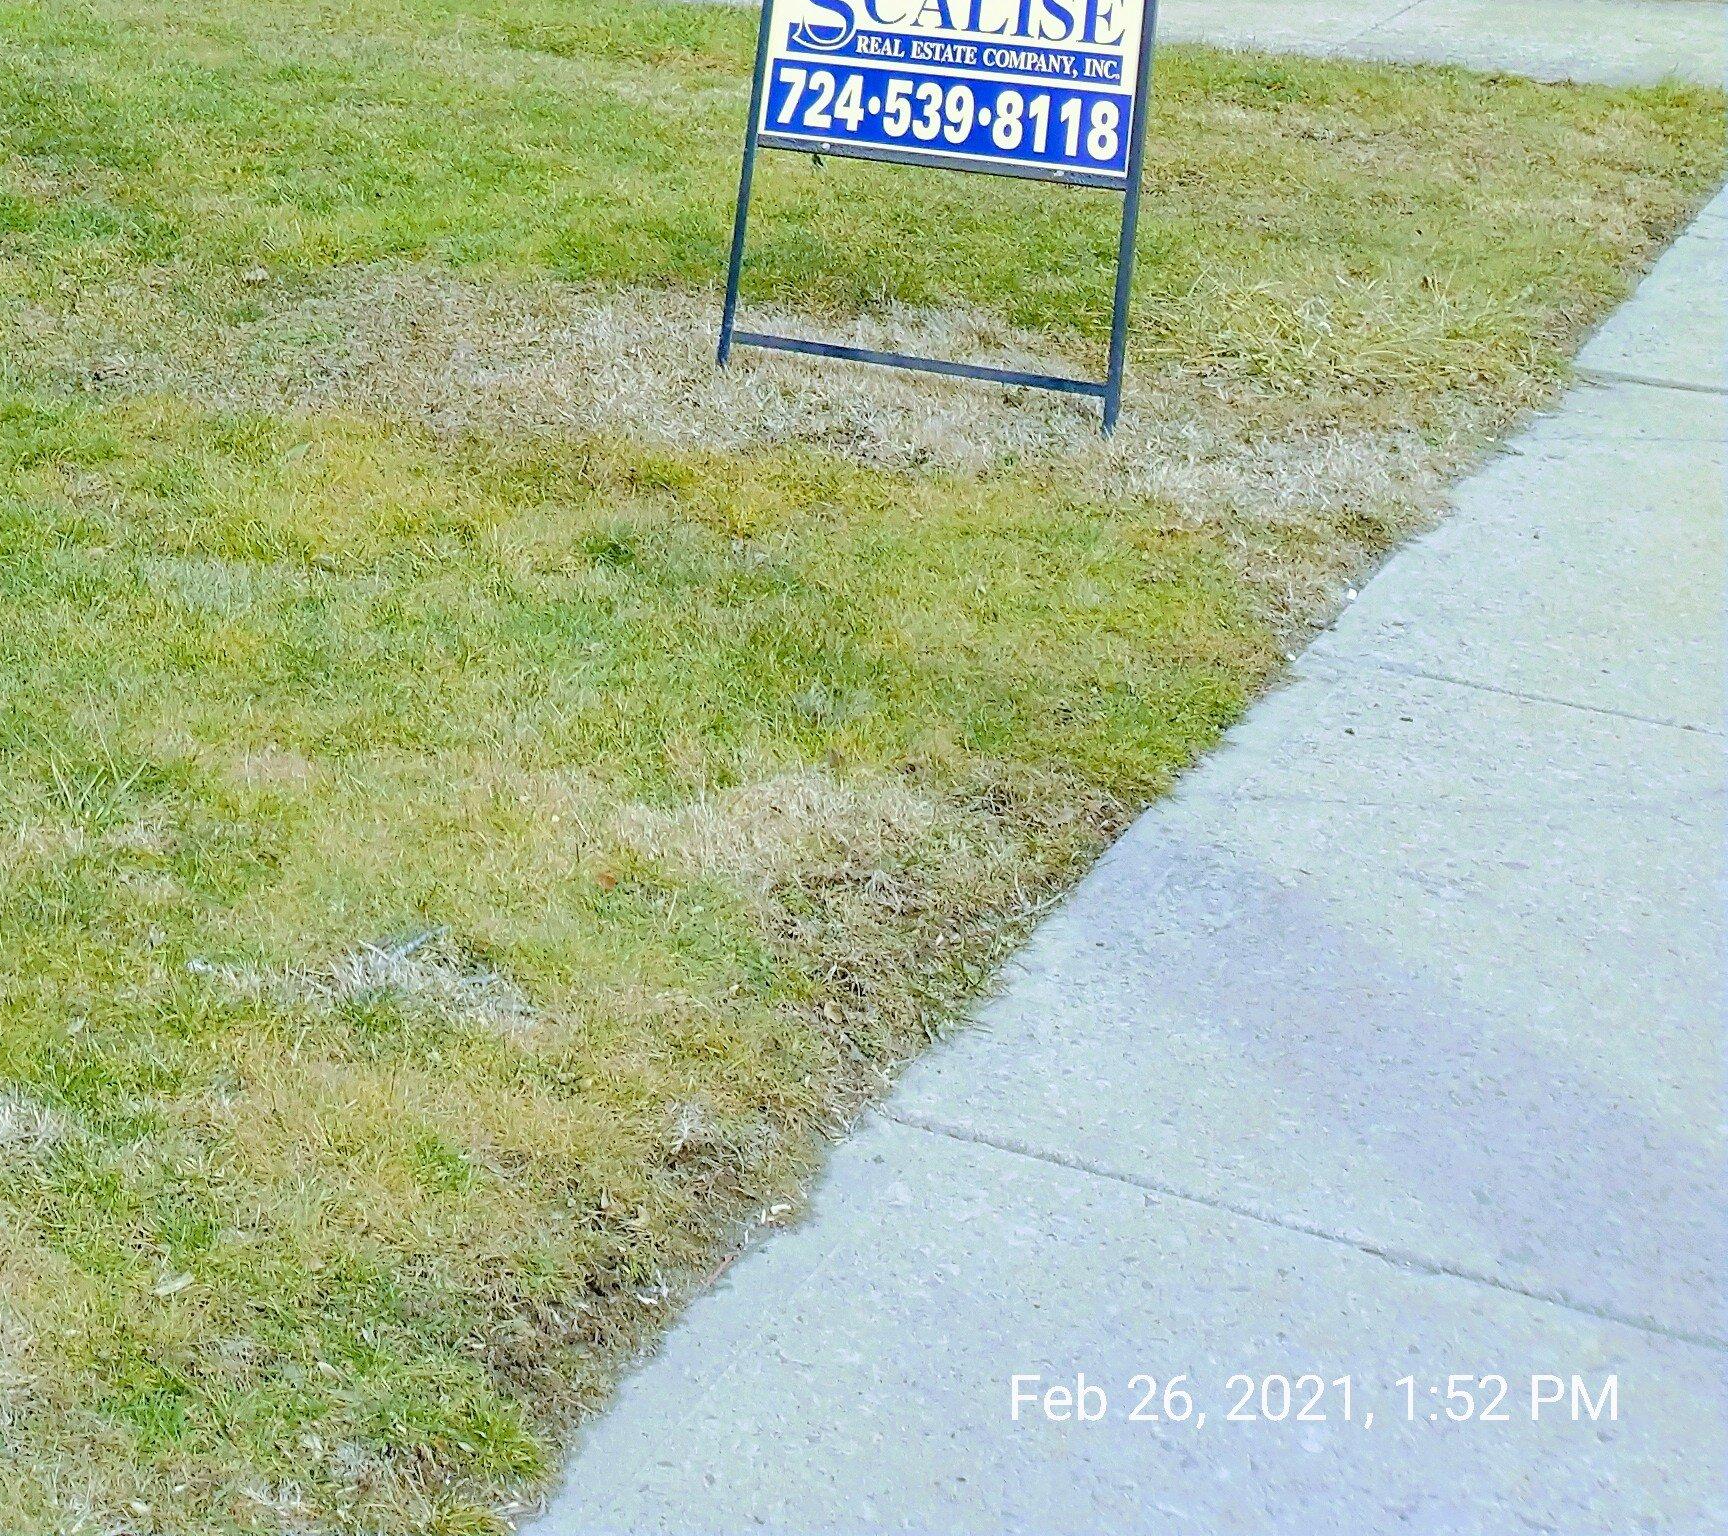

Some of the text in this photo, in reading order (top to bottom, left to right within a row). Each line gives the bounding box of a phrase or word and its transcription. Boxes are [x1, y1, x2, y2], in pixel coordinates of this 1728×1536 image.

[855, 34, 1121, 80] REAL ESTATE COMPANY, INC.
